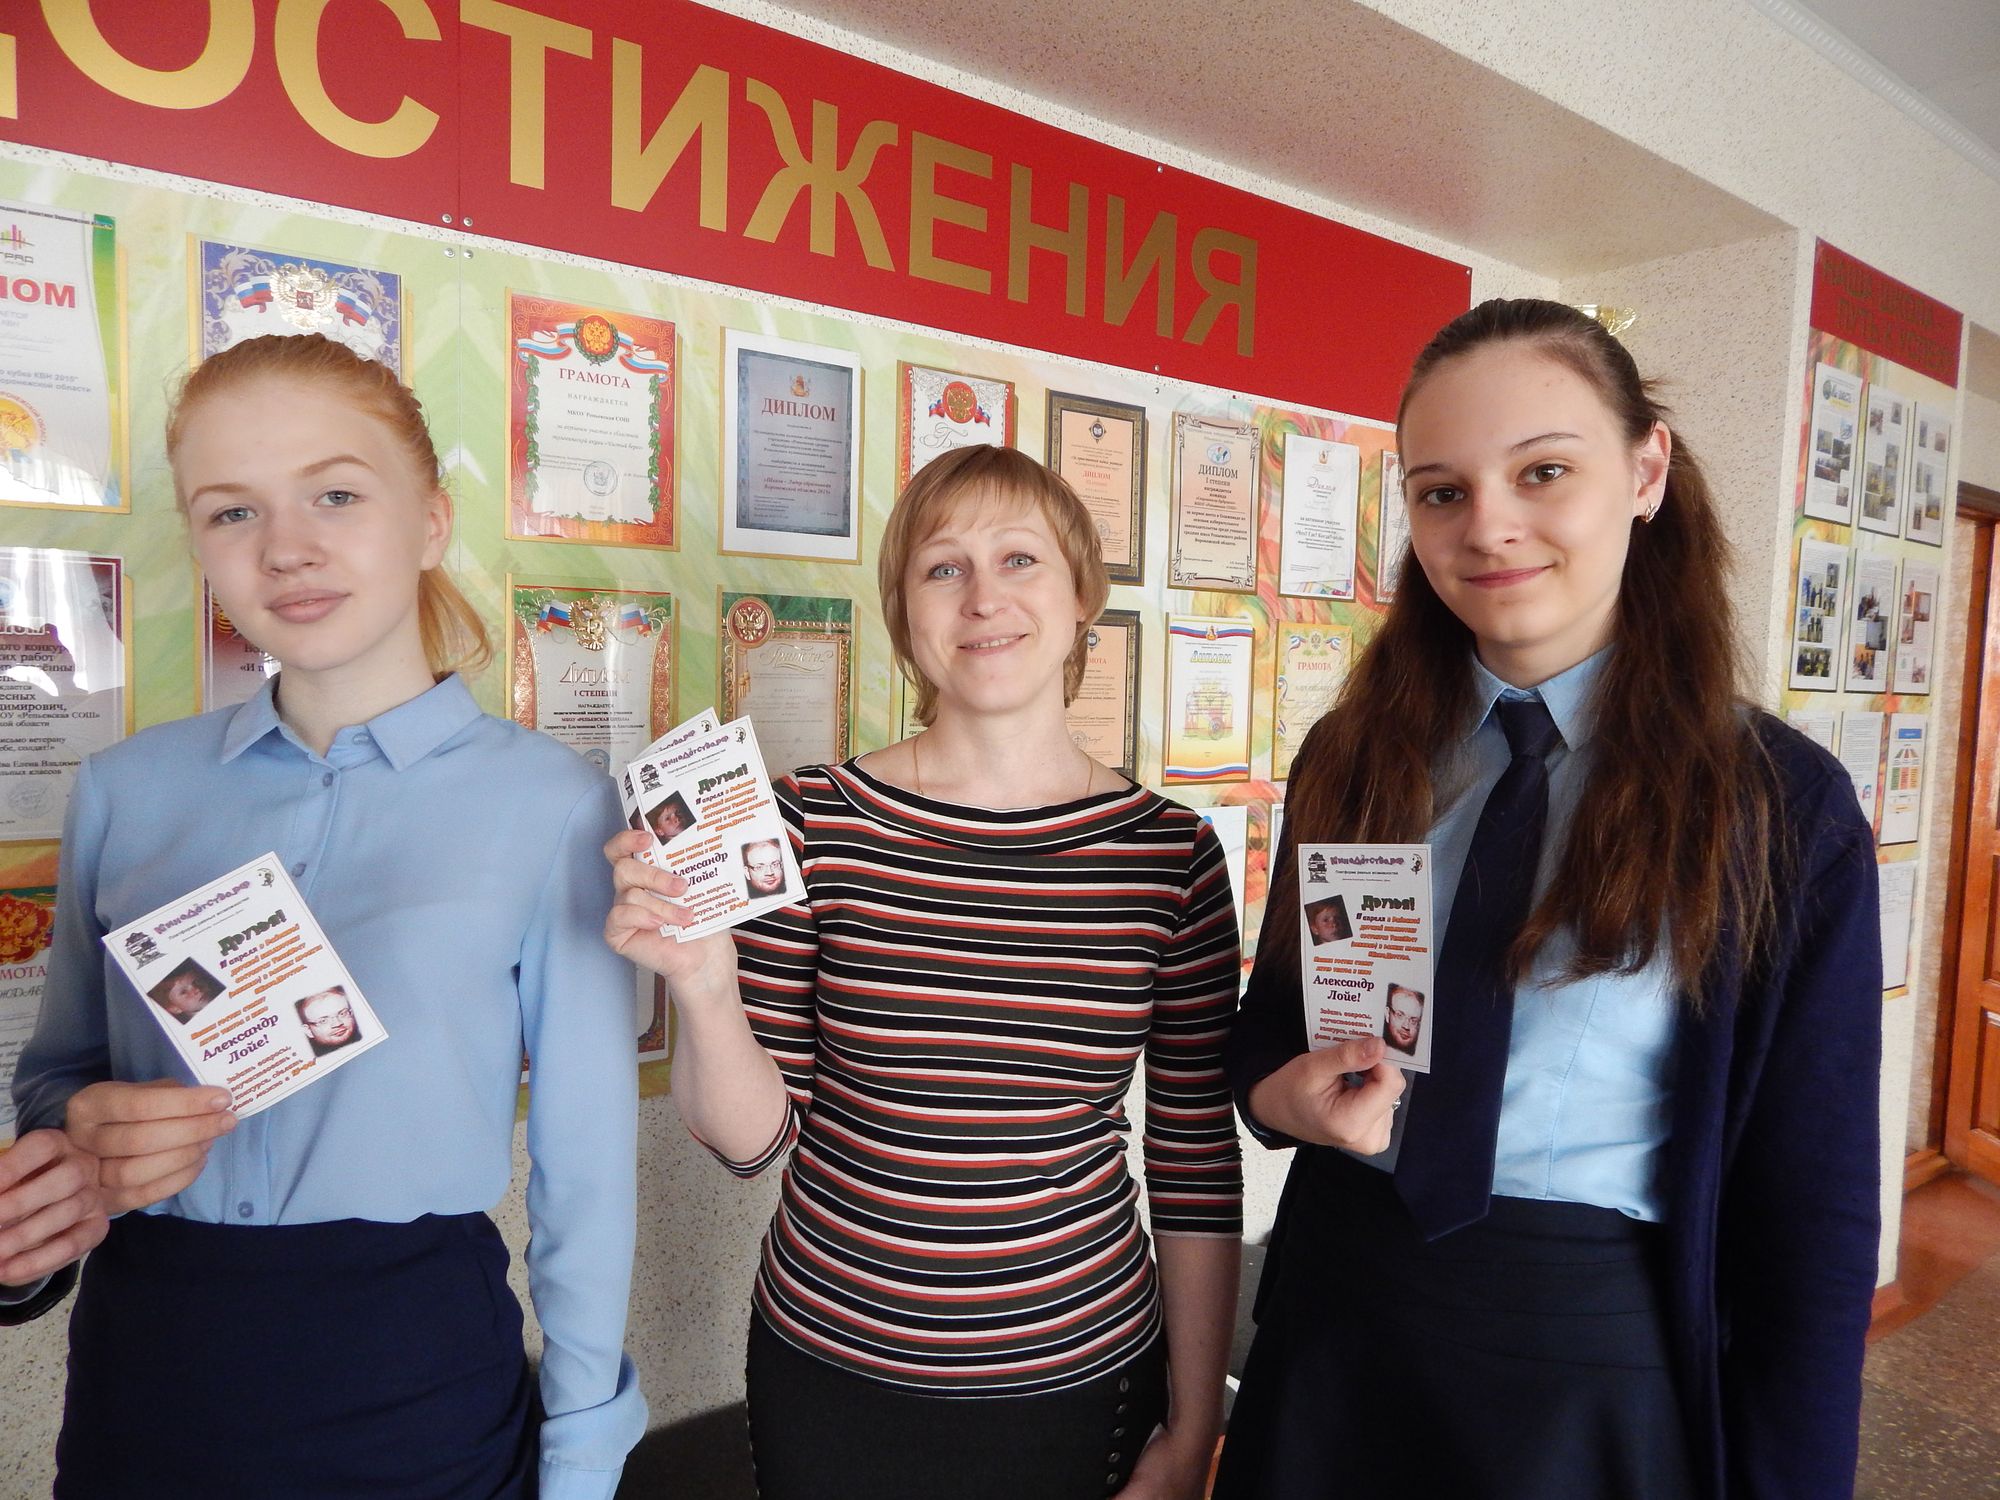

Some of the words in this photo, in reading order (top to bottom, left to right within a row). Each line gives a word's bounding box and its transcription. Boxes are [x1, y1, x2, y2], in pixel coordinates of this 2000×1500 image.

[559, 368, 631, 389] ГРАМОТА
[761, 398, 836, 422] ДИПЛОМ
[1198, 464, 1238, 479] ДИПЛОМ
[20, 653, 54, 663] работ
[1297, 661, 1332, 672] ГРАМОТА
[29, 737, 66, 745] ветерану
[698, 764, 748, 795] Друзья!
[702, 791, 724, 803] апреля
[688, 867, 718, 887] Лойе!
[1361, 895, 1415, 911] Друзья!
[218, 910, 286, 956] Друзья!
[229, 947, 258, 965] апреля
[1313, 975, 1374, 991] Александр
[1327, 990, 1361, 1002] Лойе!
[204, 1015, 278, 1061] Александр
[229, 1034, 269, 1064] Лойе!
